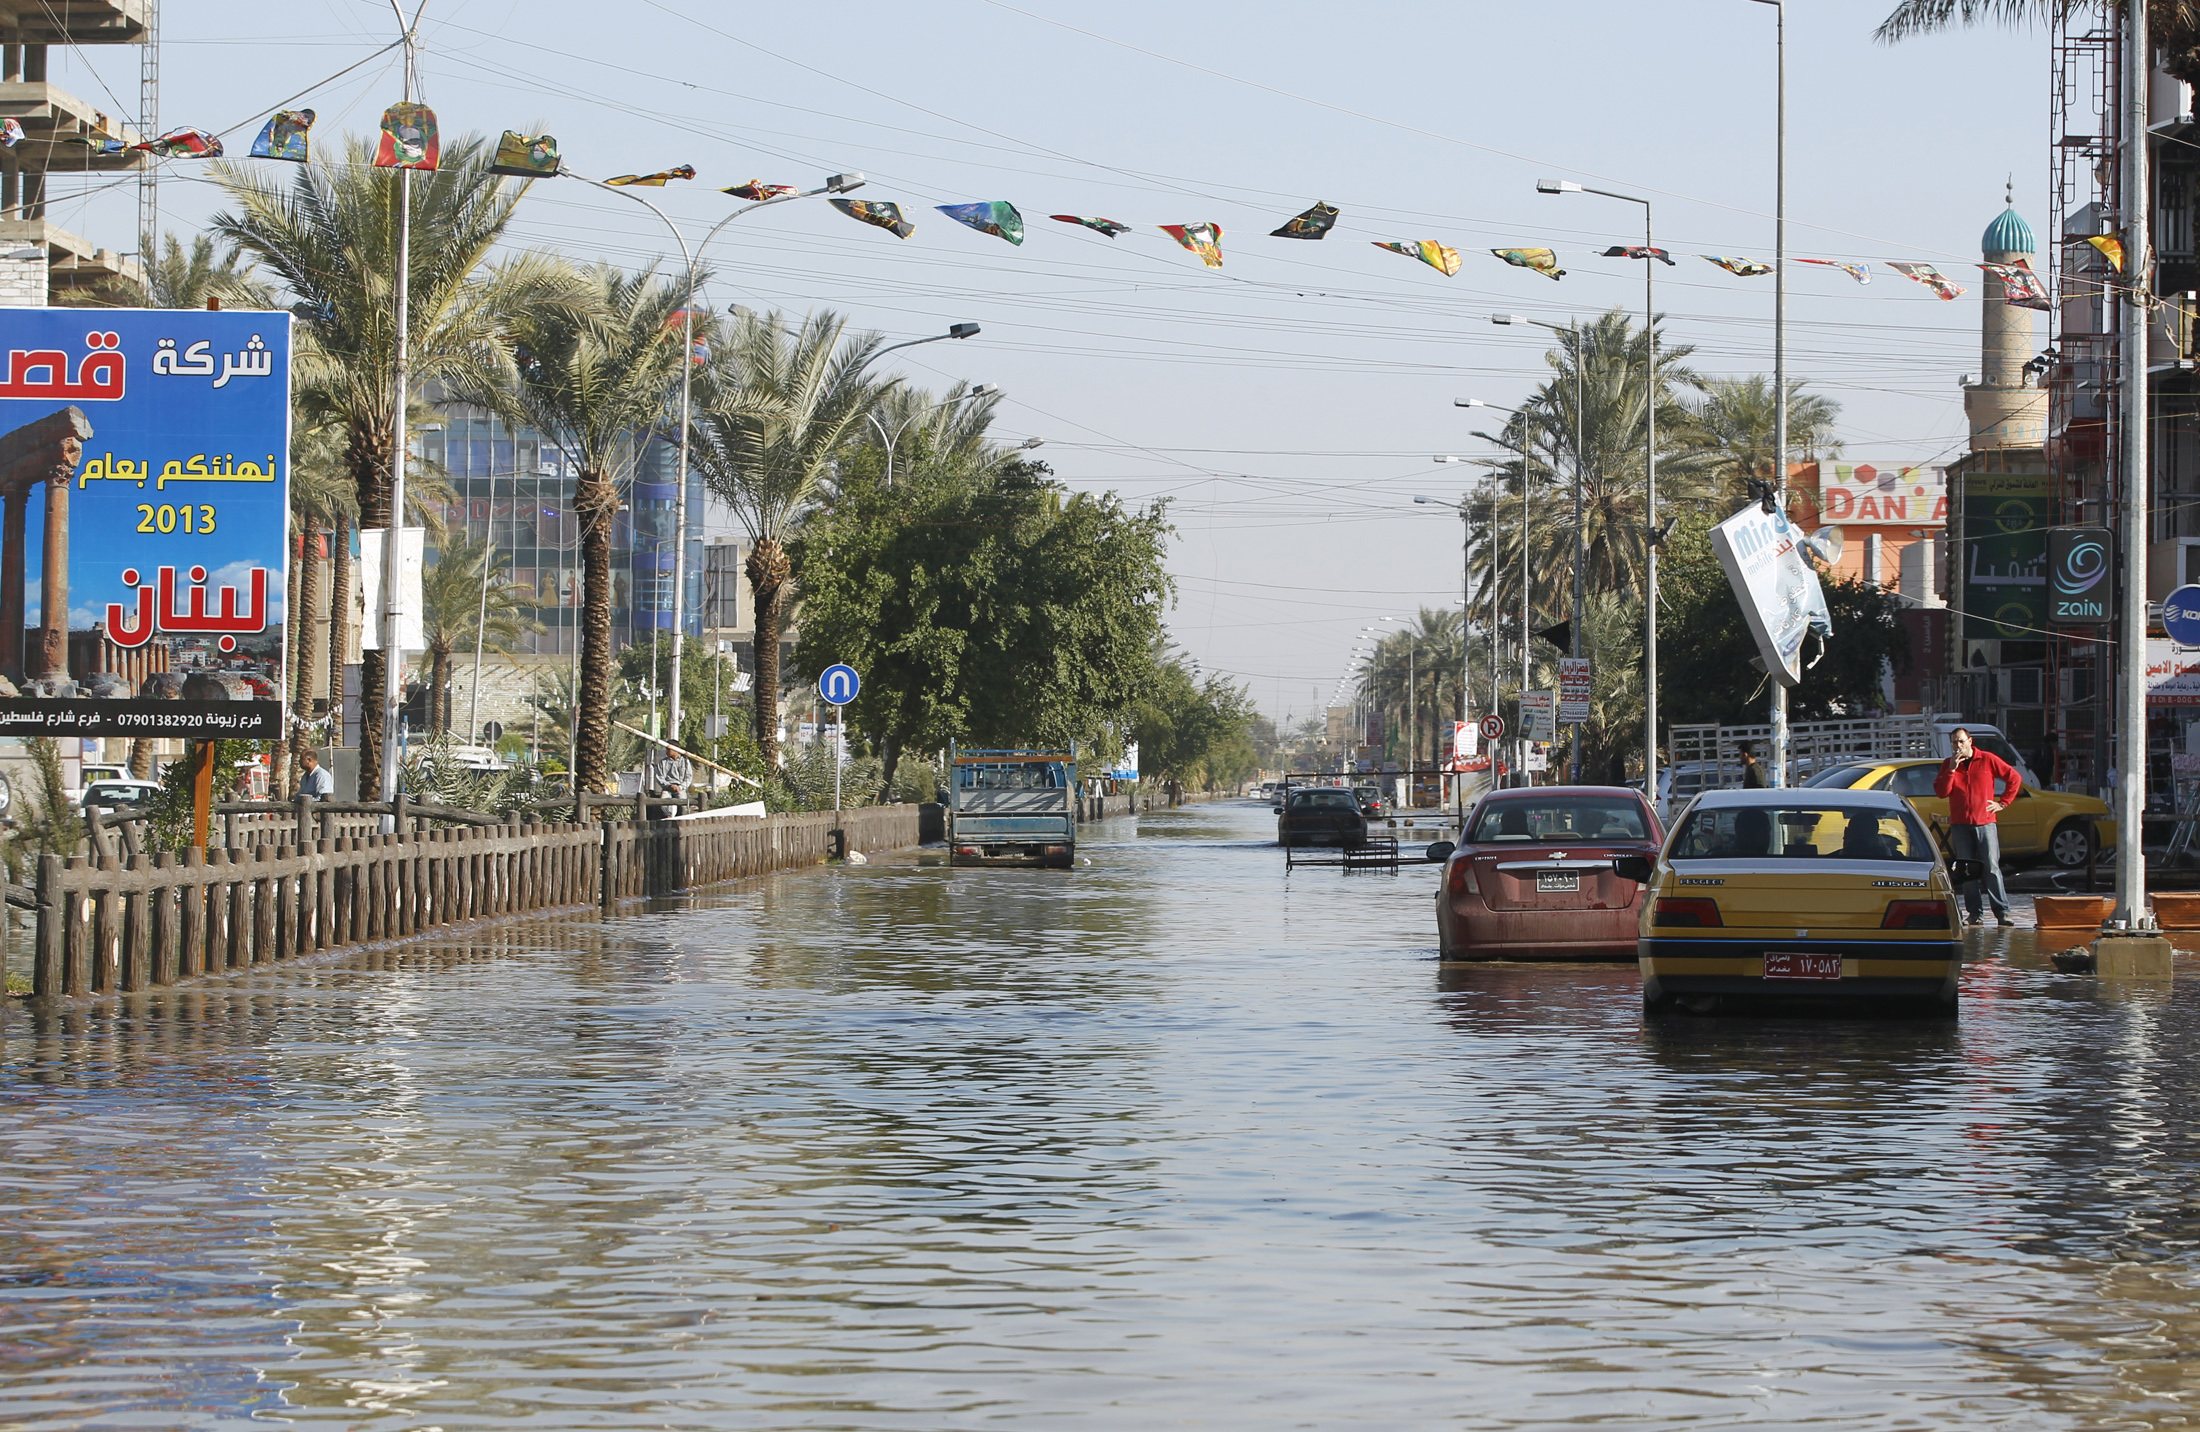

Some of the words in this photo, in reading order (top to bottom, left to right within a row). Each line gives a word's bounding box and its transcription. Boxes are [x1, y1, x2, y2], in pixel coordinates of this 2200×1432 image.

[0, 331, 126, 401] قص
[153, 334, 273, 389] شركة
[78, 452, 149, 489] بعام
[156, 453, 277, 491] نهنئكم
[136, 503, 217, 535] 2013
[106, 564, 268, 653] لبنان
[0, 711, 44, 727] فلسطين
[46, 710, 76, 728] شارع
[78, 712, 101, 728] فرع
[118, 715, 202, 727] 07901382920
[205, 714, 237, 729] زيونة
[240, 716, 262, 730] فرع
